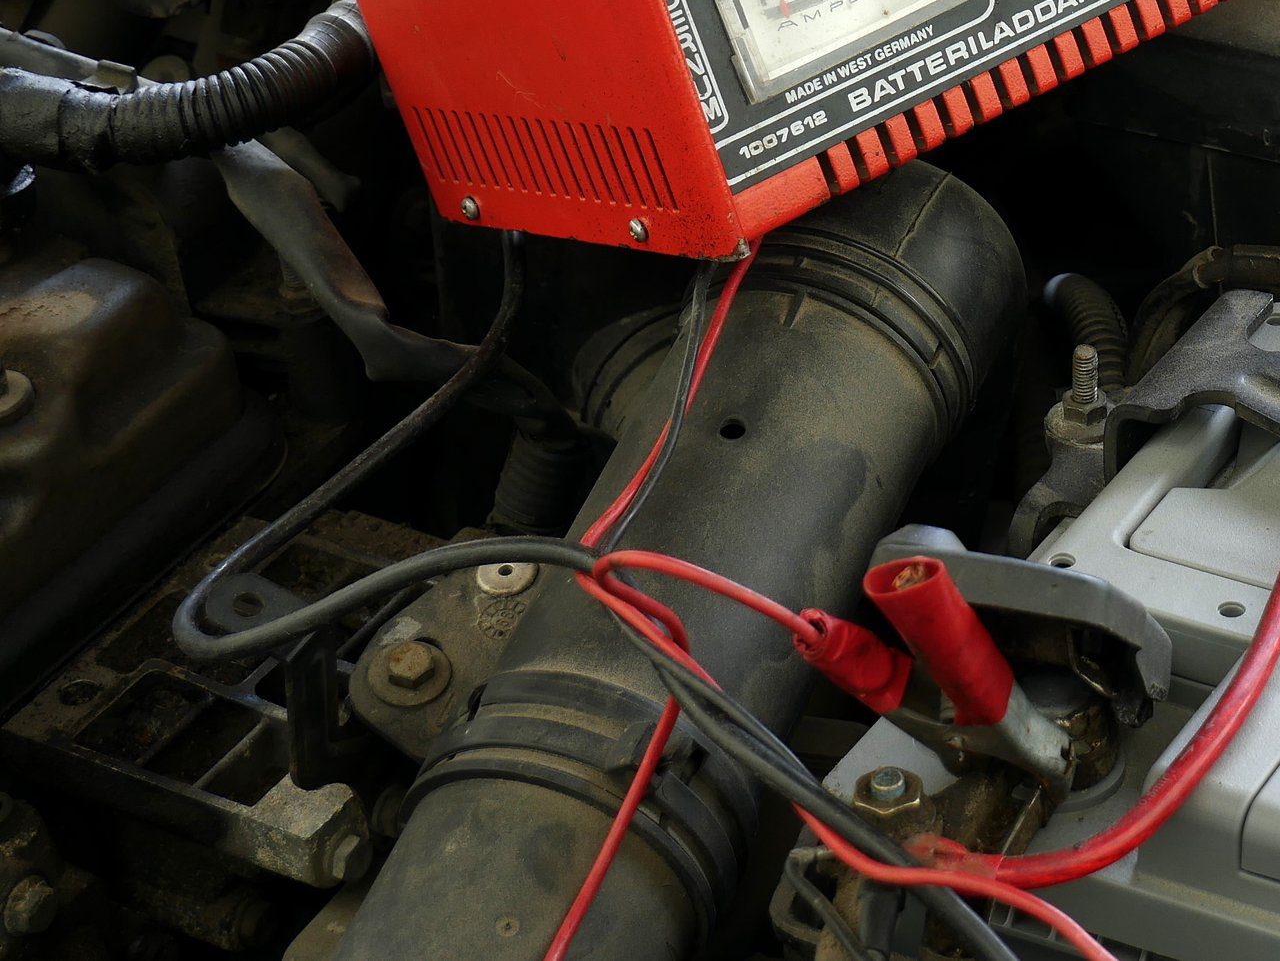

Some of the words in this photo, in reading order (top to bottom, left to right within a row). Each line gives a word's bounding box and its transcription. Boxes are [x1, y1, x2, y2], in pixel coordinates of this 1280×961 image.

[785, 81, 824, 104] MADE
[823, 71, 838, 86] IN
[837, 53, 873, 78] WEST
[874, 24, 935, 60] GERMANY
[739, 110, 828, 159] 1007612
